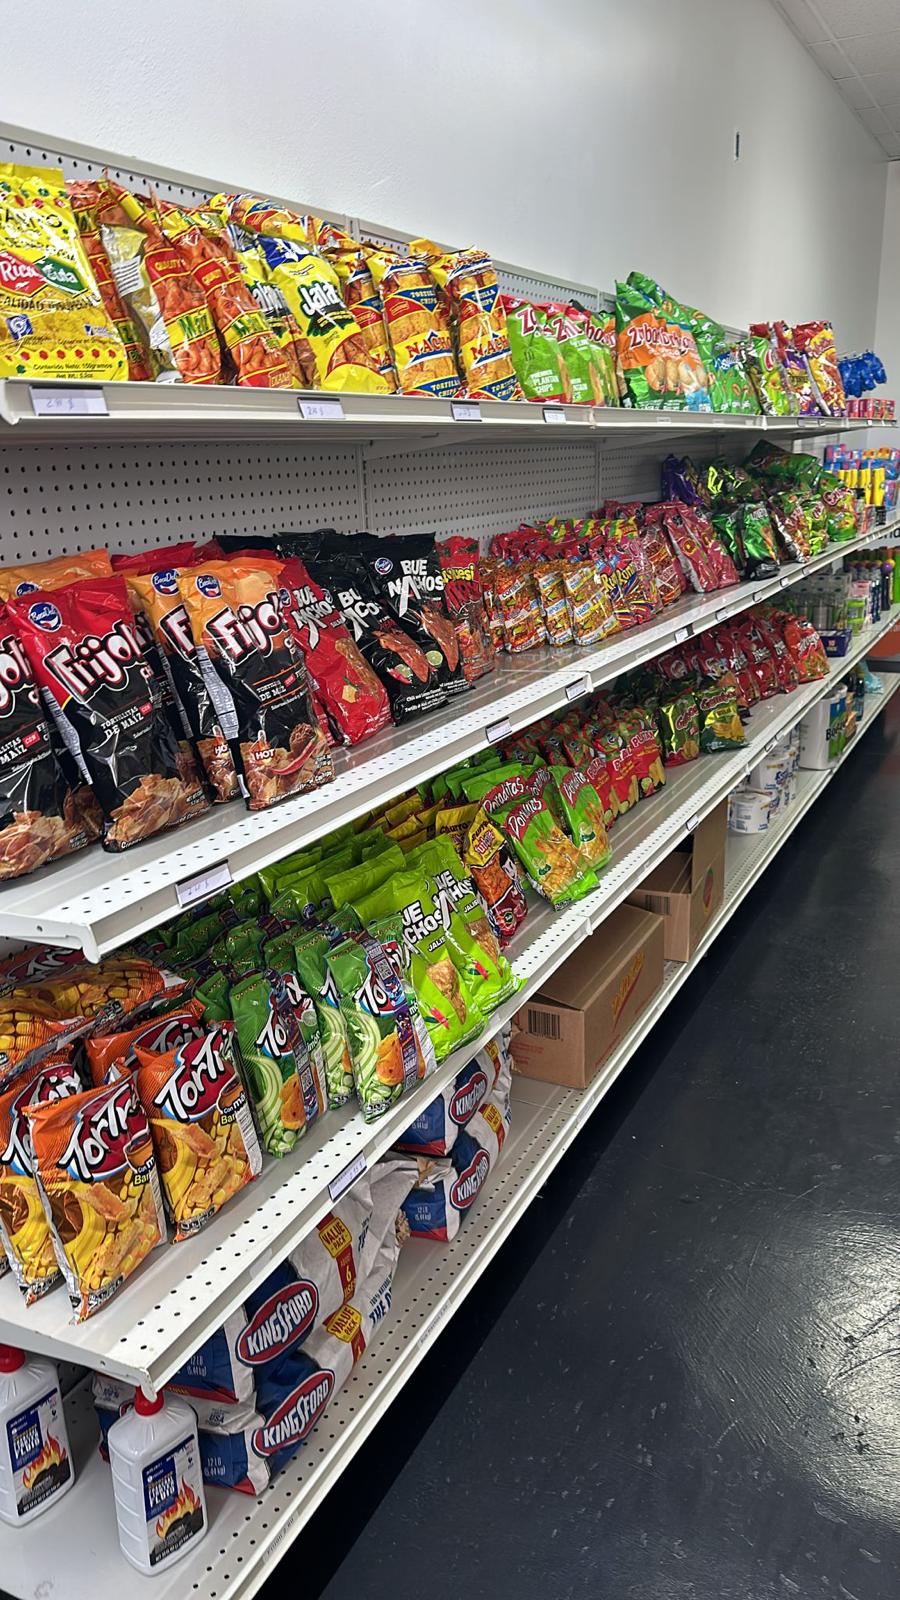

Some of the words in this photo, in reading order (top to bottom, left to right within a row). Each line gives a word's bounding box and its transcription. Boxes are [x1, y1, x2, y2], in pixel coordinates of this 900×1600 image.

[410, 289, 436, 298] TORTILL
[0, 294, 44, 311] ALIDAD
[400, 559, 428, 576] BUE
[387, 575, 445, 618] NACHOS
[104, 725, 121, 738] DE
[256, 749, 275, 760] HOT
[306, 1030, 322, 1052] imón
[322, 1220, 346, 1245] VALUE
[333, 1236, 346, 1251] PACK
[346, 1265, 352, 1282] 6
[246, 1290, 313, 1357] KINGSFORD
[331, 1306, 355, 1335] VALUE
[344, 1318, 358, 1336] PACK
[263, 1378, 330, 1447] KINGSFORD
